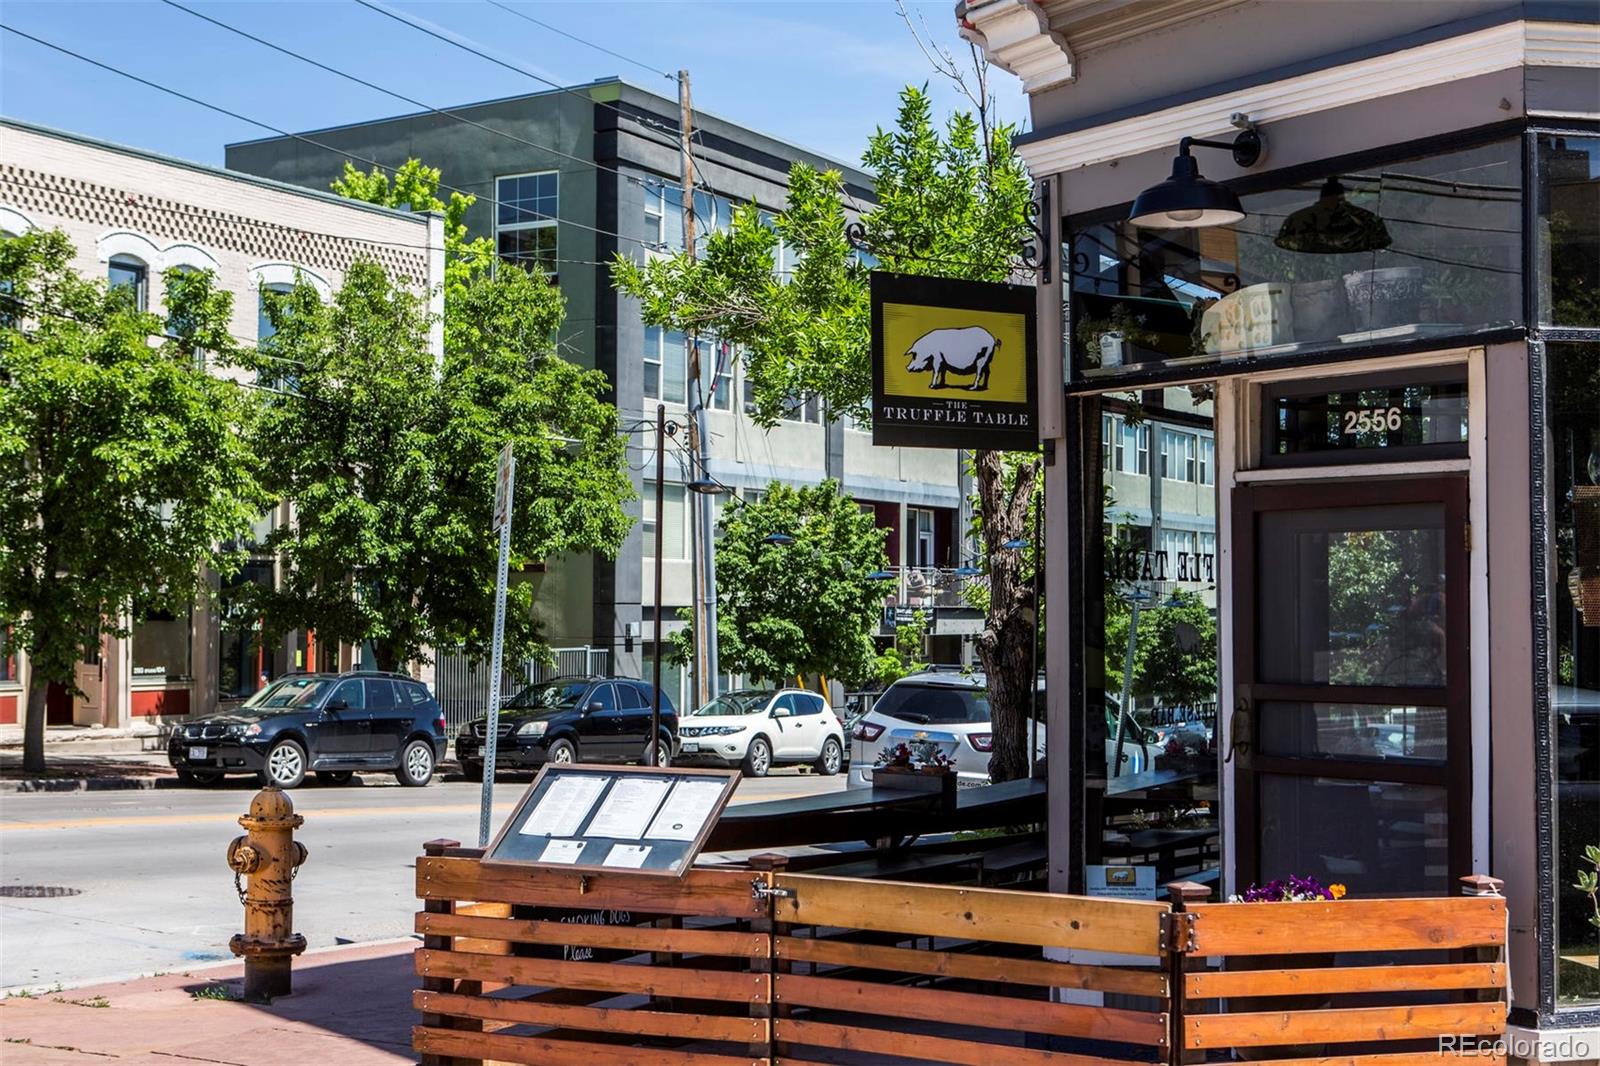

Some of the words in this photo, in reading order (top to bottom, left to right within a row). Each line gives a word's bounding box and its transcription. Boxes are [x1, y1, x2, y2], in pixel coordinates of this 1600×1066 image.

[946, 401, 967, 409] THE
[883, 406, 967, 423] TRUFFLE
[973, 411, 1029, 426] TABLE
[1344, 407, 1401, 434] 2556
